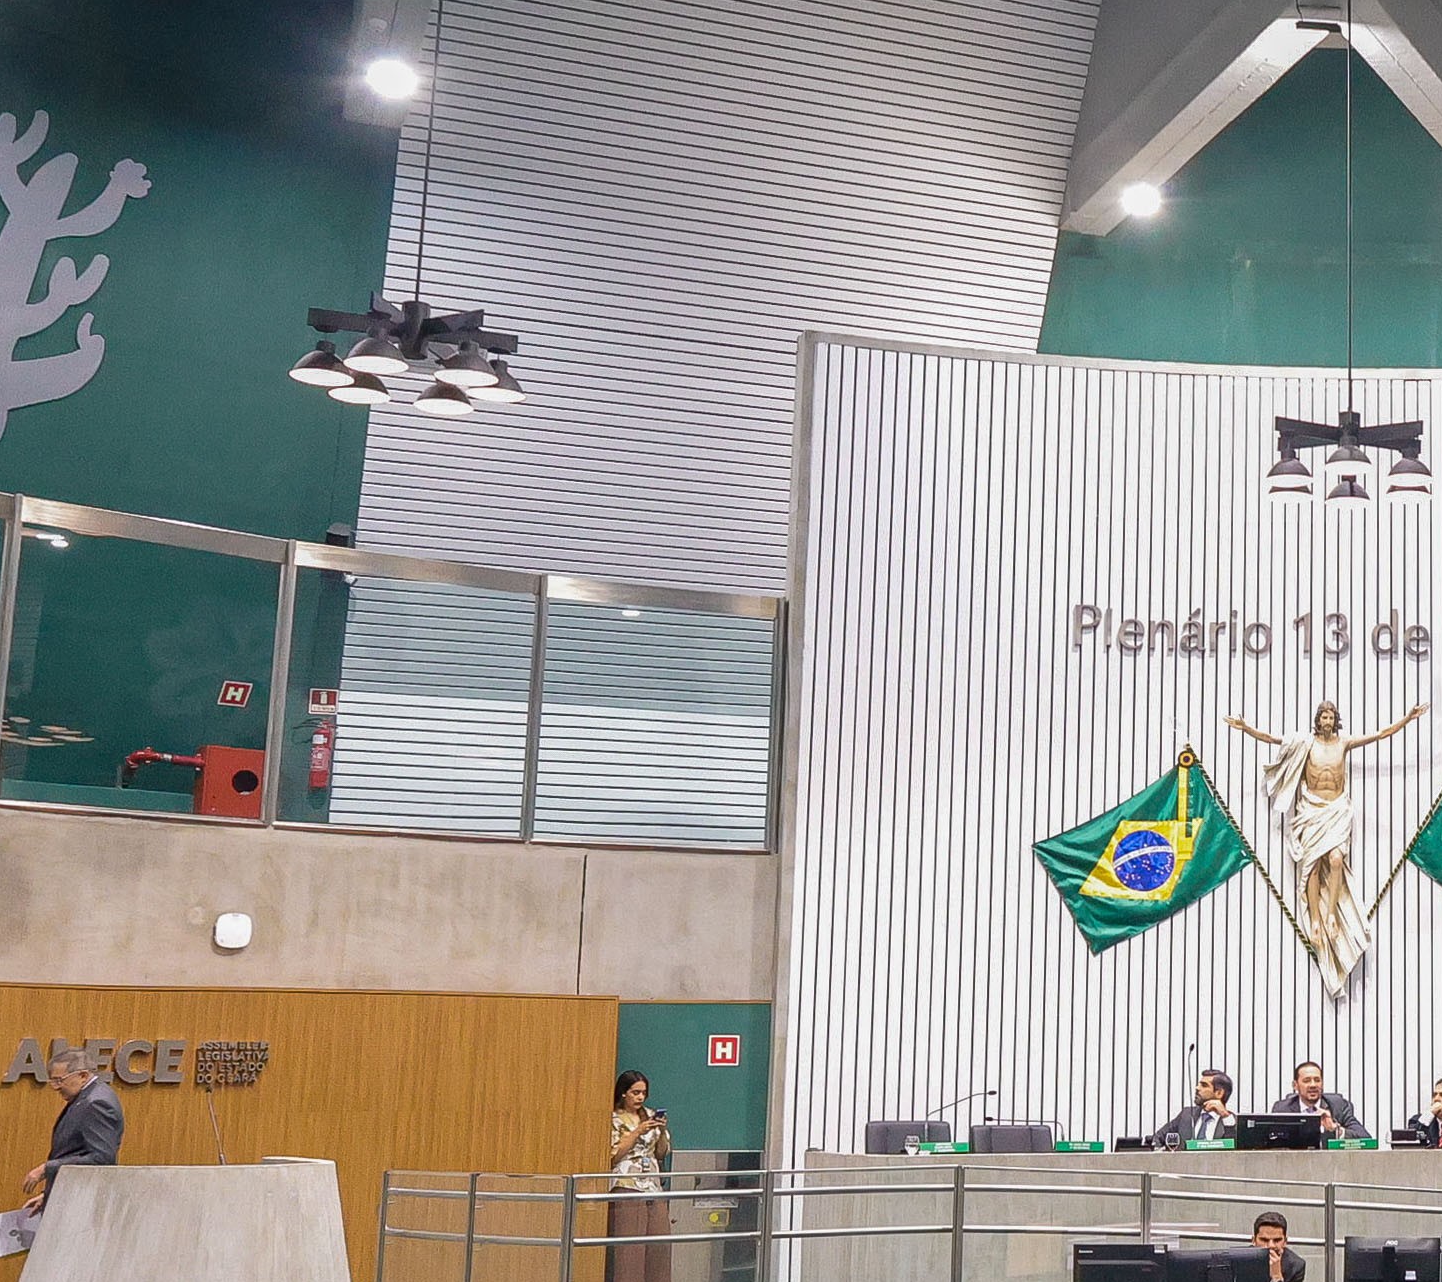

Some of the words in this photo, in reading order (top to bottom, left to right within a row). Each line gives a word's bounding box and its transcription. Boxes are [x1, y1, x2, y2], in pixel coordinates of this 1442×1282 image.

[1071, 604, 1273, 657] Plenário
[1293, 612, 1349, 657] 13
[1371, 608, 1430, 657] de
[198, 1051, 270, 1061] LEGISLATIVA
[715, 1041, 733, 1060] H
[197, 1062, 215, 1072] DO
[218, 1062, 265, 1073] ESTADO
[196, 1073, 214, 1083] DO
